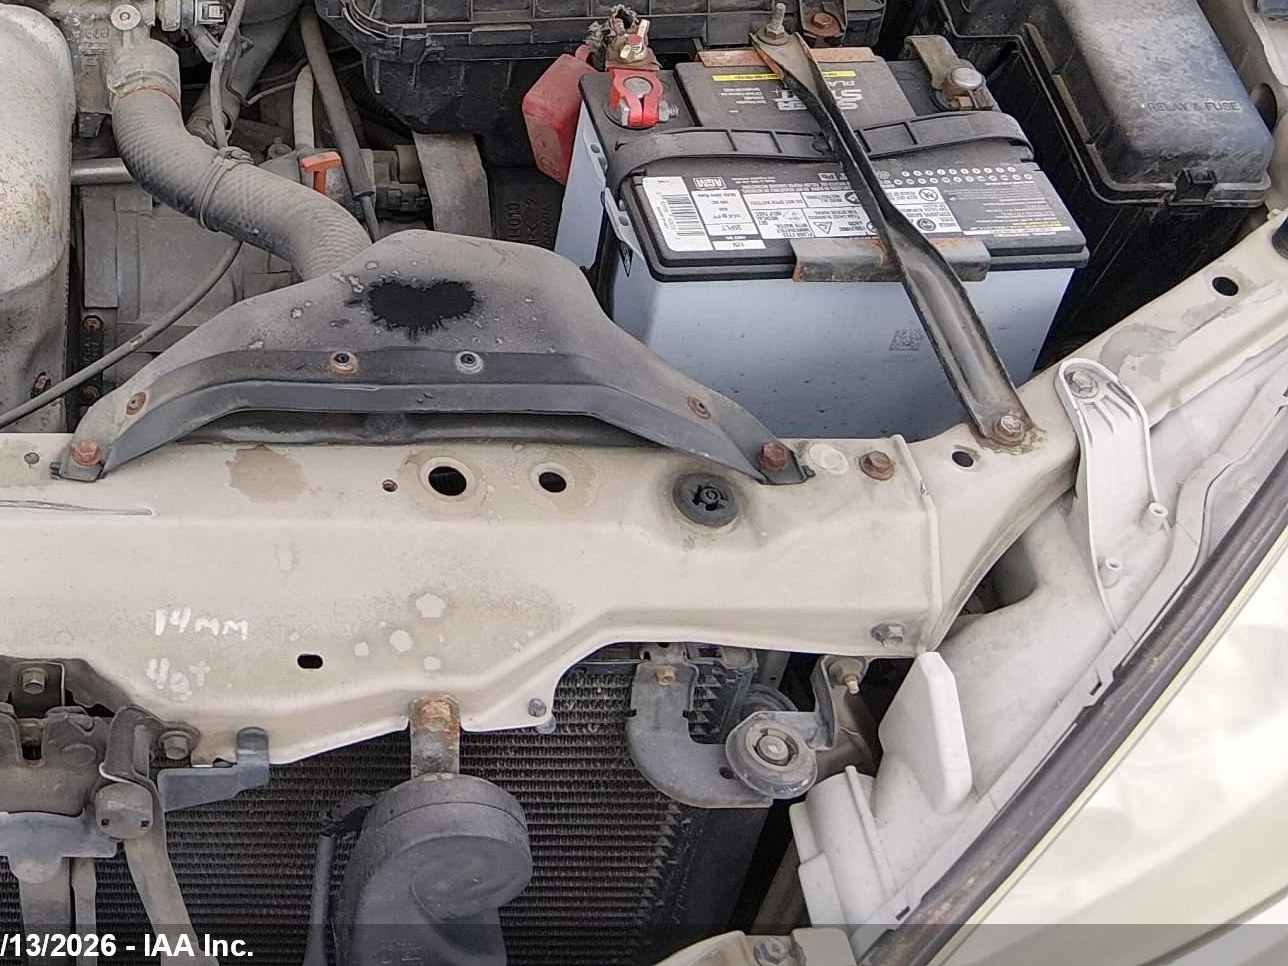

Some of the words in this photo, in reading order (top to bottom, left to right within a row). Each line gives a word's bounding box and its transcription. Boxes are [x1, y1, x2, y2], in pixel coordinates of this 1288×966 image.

[1147, 101, 1189, 113] RELAY
[1206, 100, 1242, 112] FUSE
[696, 179, 722, 187] AGM
